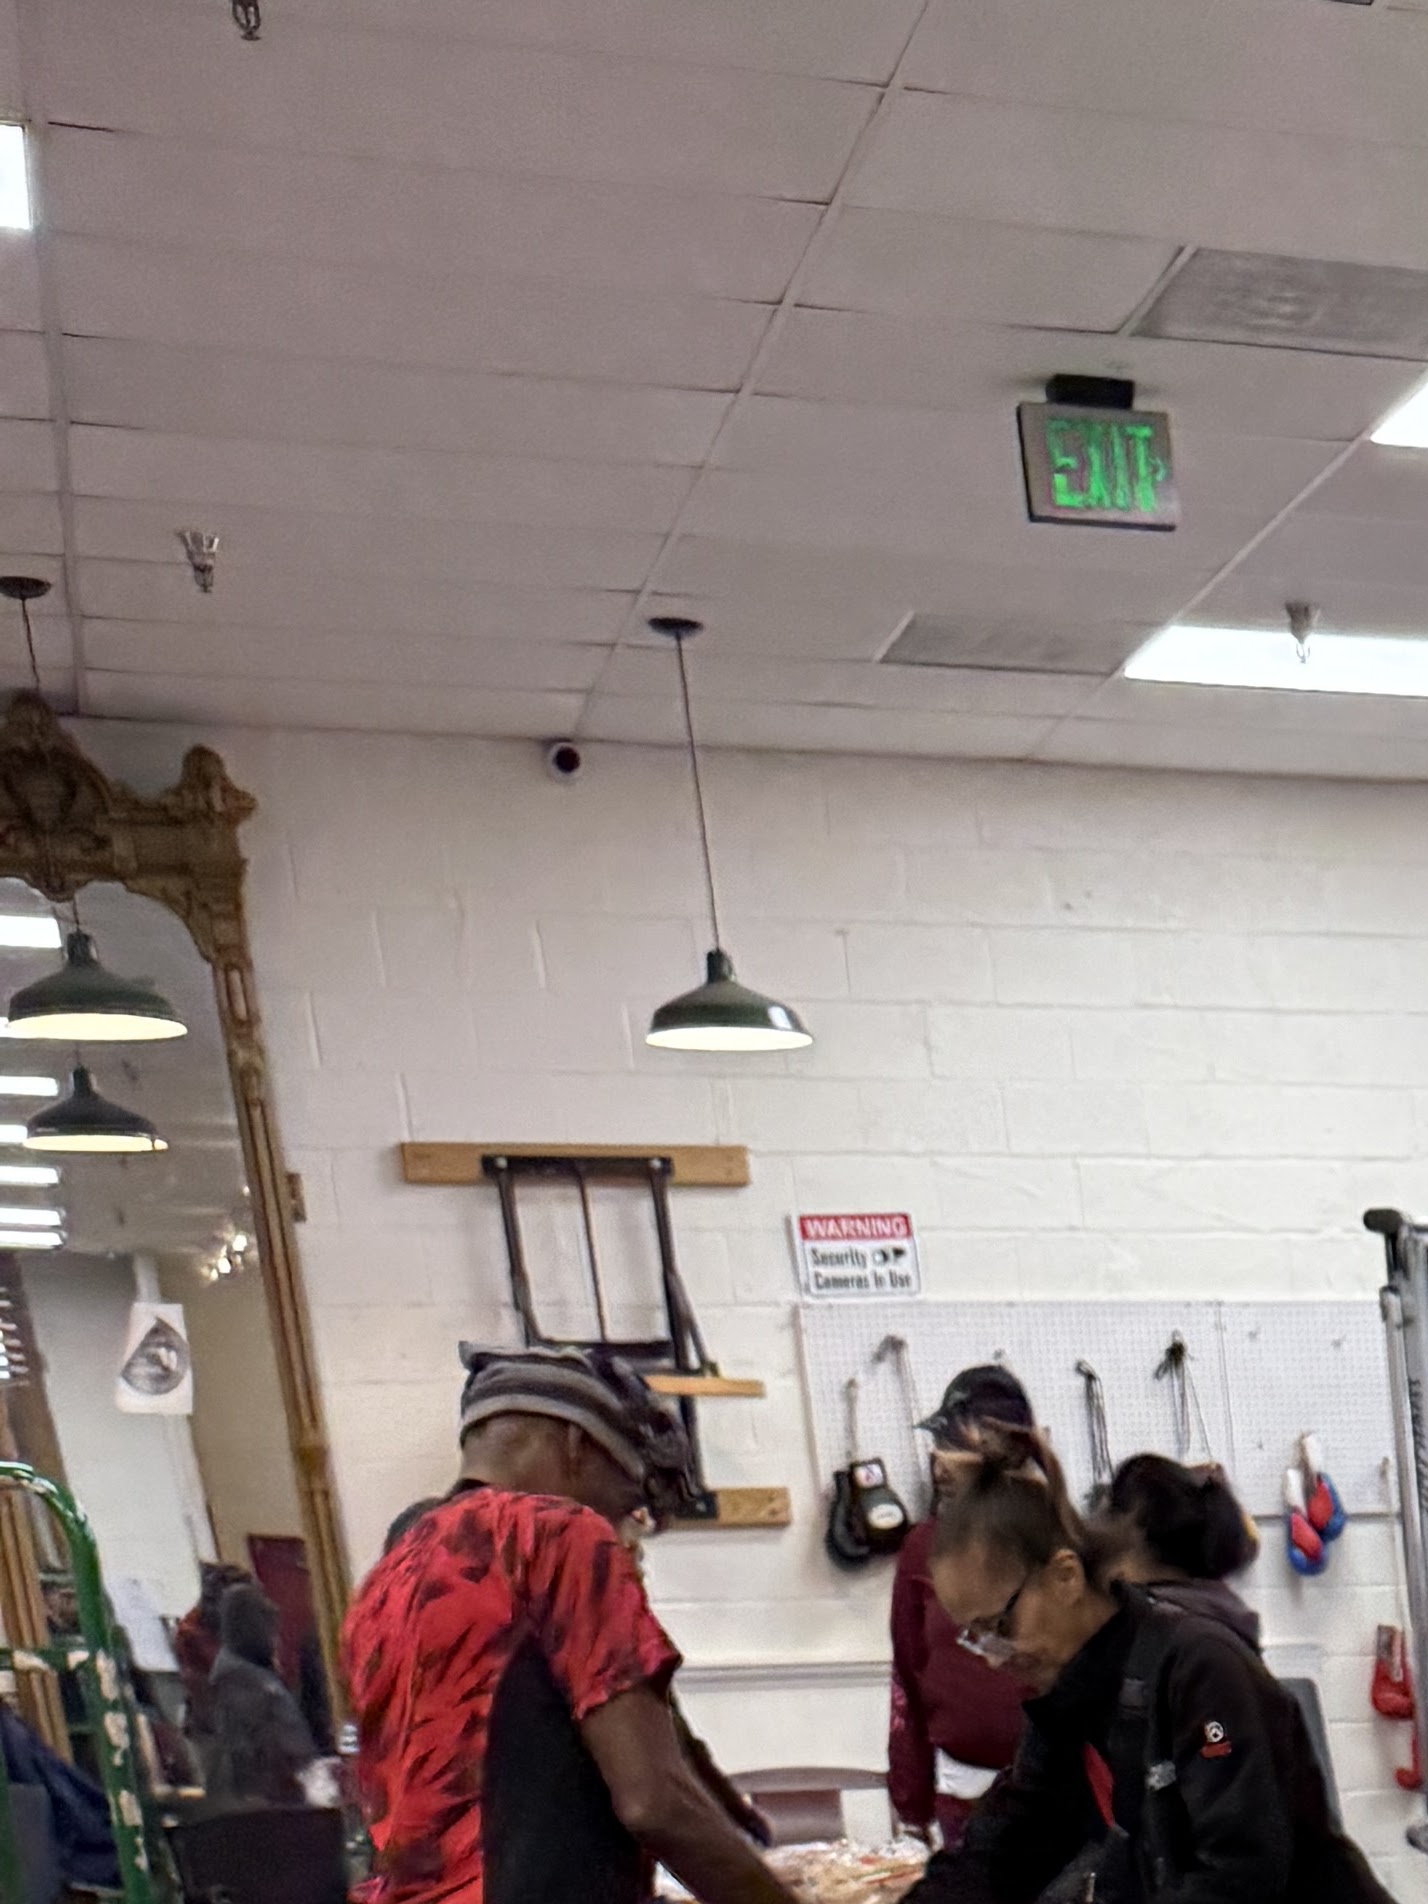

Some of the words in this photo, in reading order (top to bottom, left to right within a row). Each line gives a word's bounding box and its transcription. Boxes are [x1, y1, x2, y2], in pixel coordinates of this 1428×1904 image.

[1048, 417, 1157, 512] EXIT
[805, 1217, 908, 1237] WARNING
[811, 1247, 867, 1268] Security
[814, 1271, 870, 1290] Cameras
[874, 1271, 884, 1287] In
[889, 1269, 911, 1288] Use
